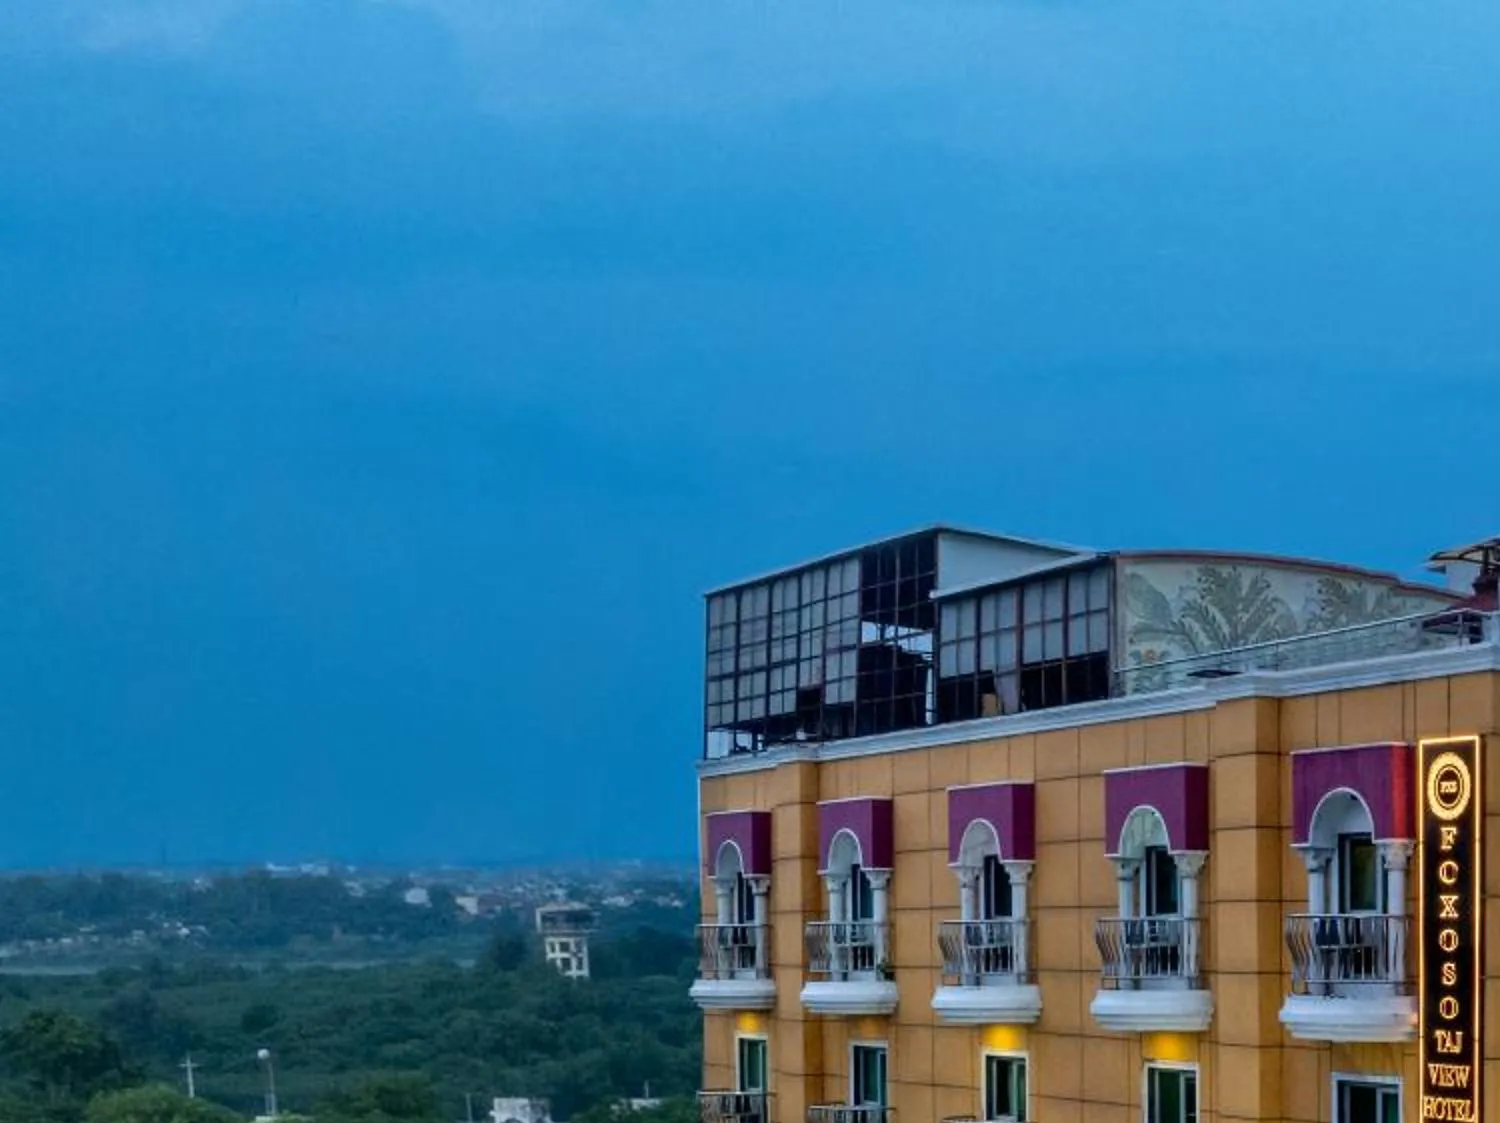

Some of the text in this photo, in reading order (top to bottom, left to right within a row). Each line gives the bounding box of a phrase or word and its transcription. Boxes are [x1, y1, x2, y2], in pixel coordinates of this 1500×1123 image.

[1434, 1029, 1463, 1053] TAJ
[1428, 1063, 1470, 1088] VIEW
[1423, 1095, 1475, 1122] HOTEL
